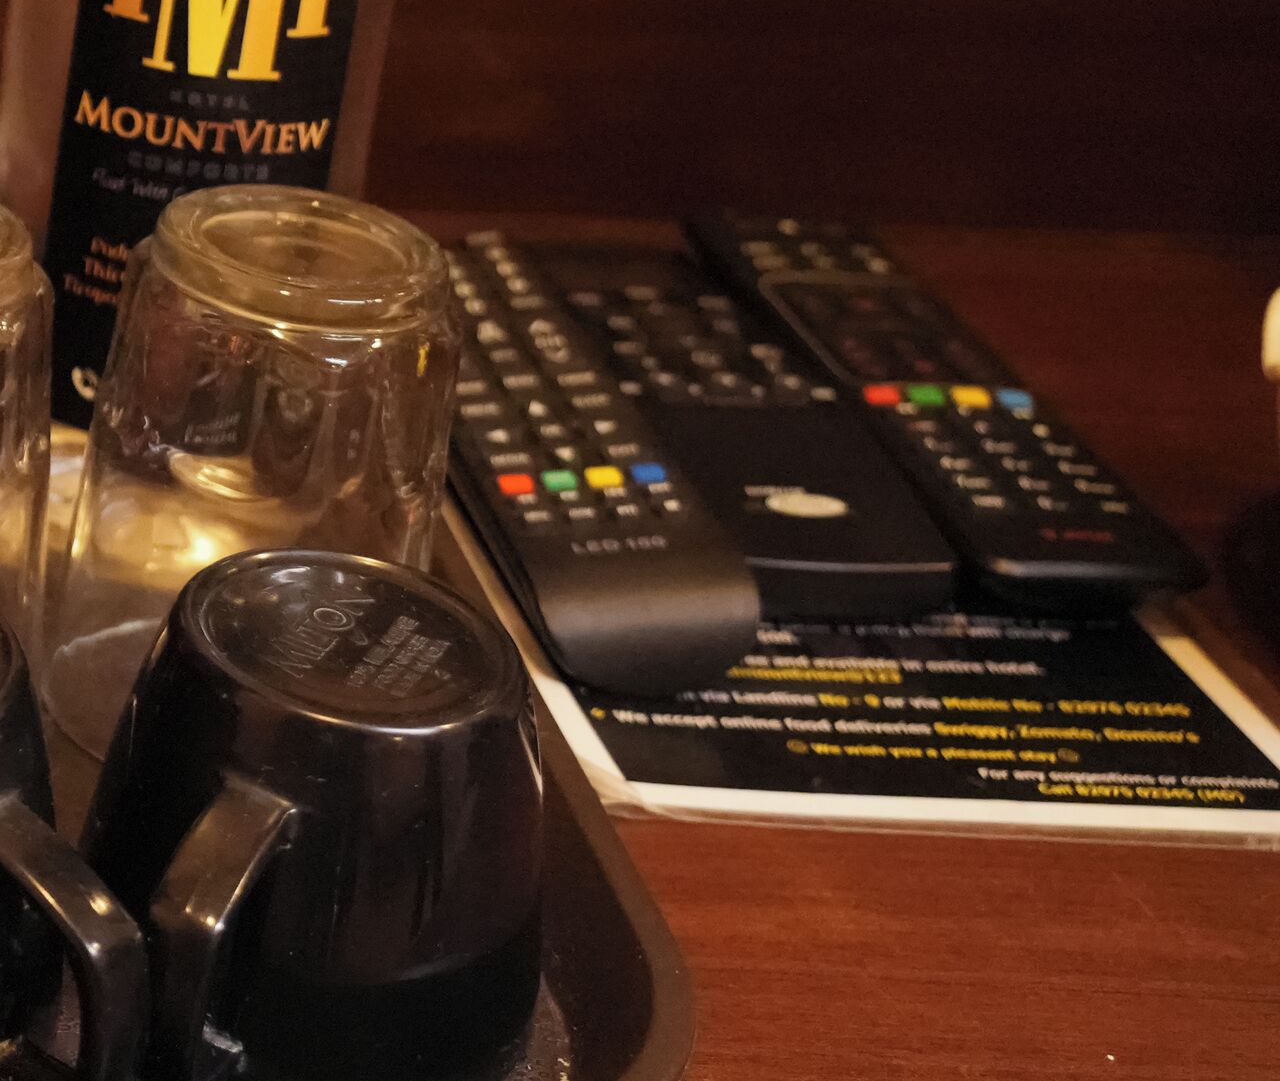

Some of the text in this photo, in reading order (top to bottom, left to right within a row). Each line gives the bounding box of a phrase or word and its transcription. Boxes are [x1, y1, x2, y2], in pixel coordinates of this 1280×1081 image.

[731, 689, 819, 708] Landline
[882, 695, 906, 710] or
[907, 695, 941, 712] via
[942, 695, 1011, 713] Mobile
[1010, 697, 1042, 713] No
[611, 708, 649, 724] We
[650, 711, 719, 730] accept
[718, 714, 785, 732] online
[783, 715, 833, 733] food
[833, 717, 933, 736] deliveries
[810, 741, 843, 757] We
[842, 743, 888, 758] wish
[888, 745, 924, 762] you
[940, 745, 1017, 763] pleasant
[1017, 749, 1057, 766] stay
[976, 766, 1009, 782] For
[1012, 769, 1046, 787] any
[1047, 770, 1158, 788] suggestions
[1157, 773, 1178, 786] or
